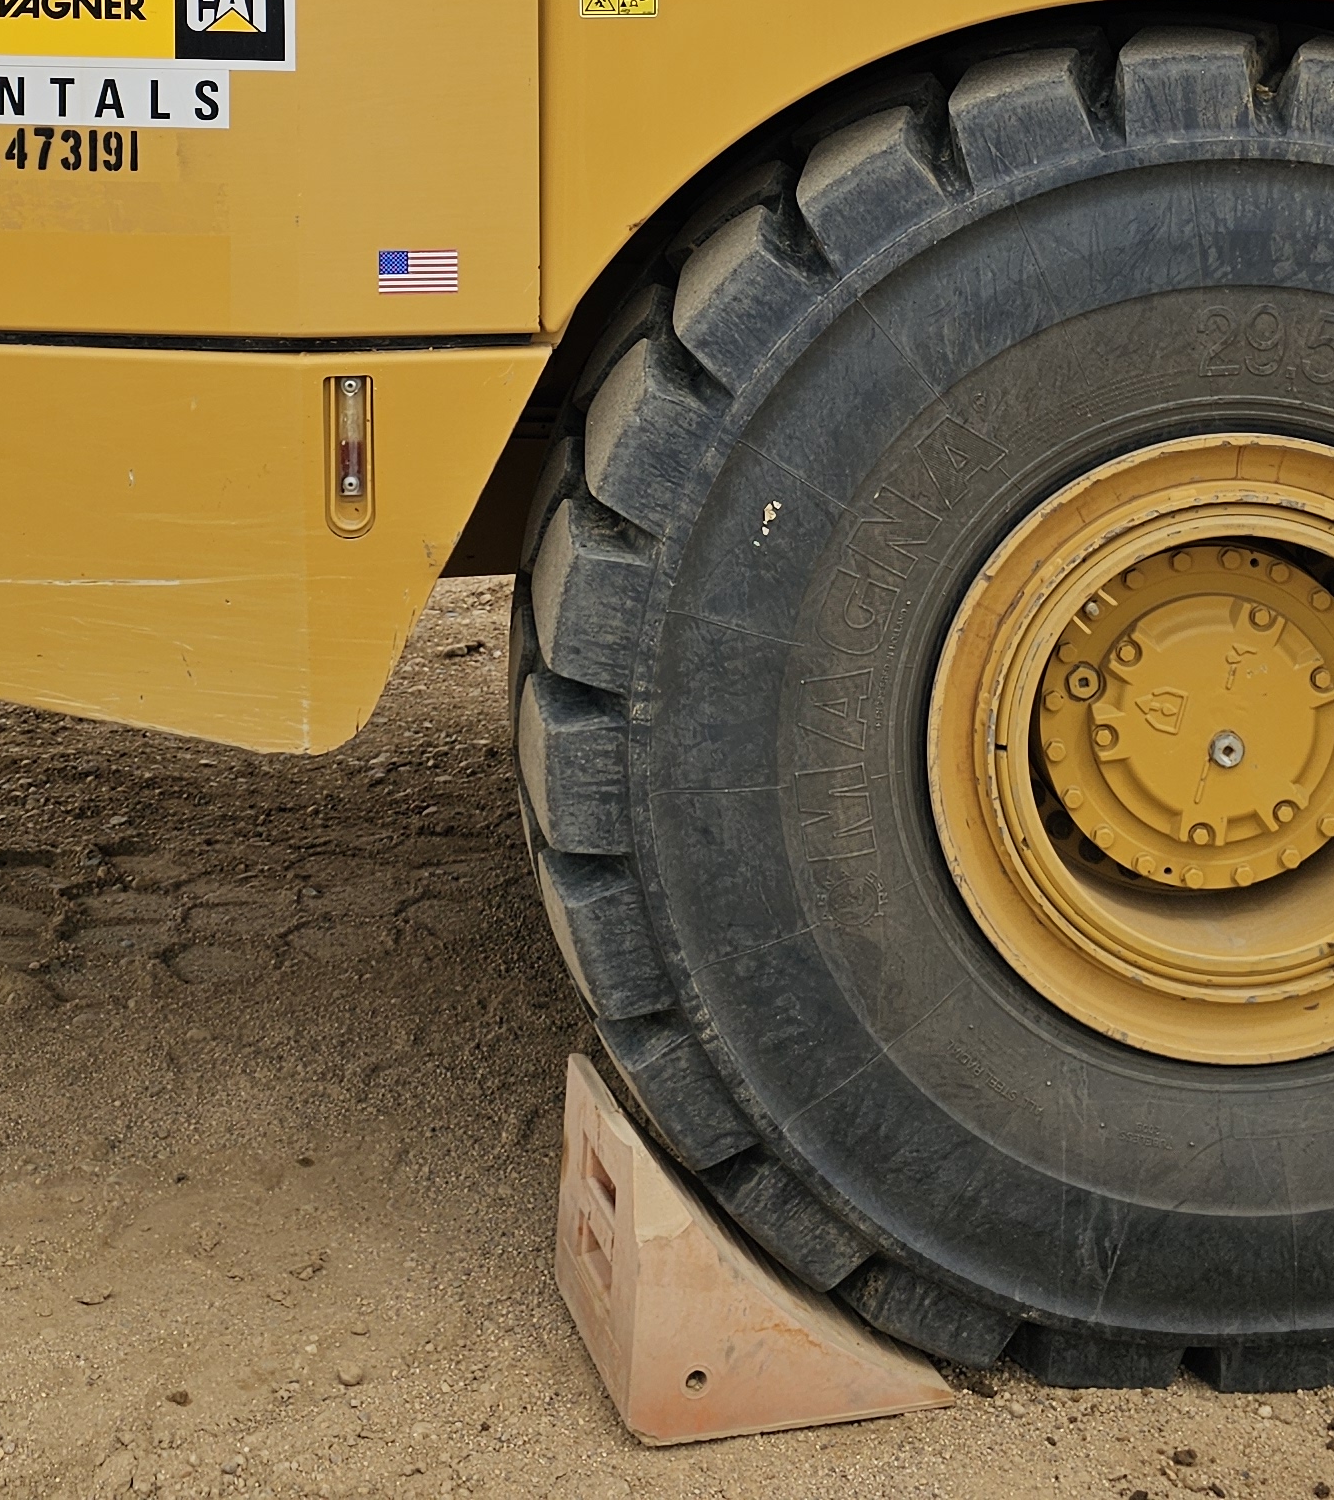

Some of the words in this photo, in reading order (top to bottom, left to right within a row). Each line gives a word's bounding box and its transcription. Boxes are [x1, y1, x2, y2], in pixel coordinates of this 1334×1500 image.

[794, 414, 1009, 862] MAGNA
[947, 1038, 986, 1077] RADIAL
[985, 1071, 1018, 1102] STEEL
[1024, 1097, 1045, 1116] ALL
